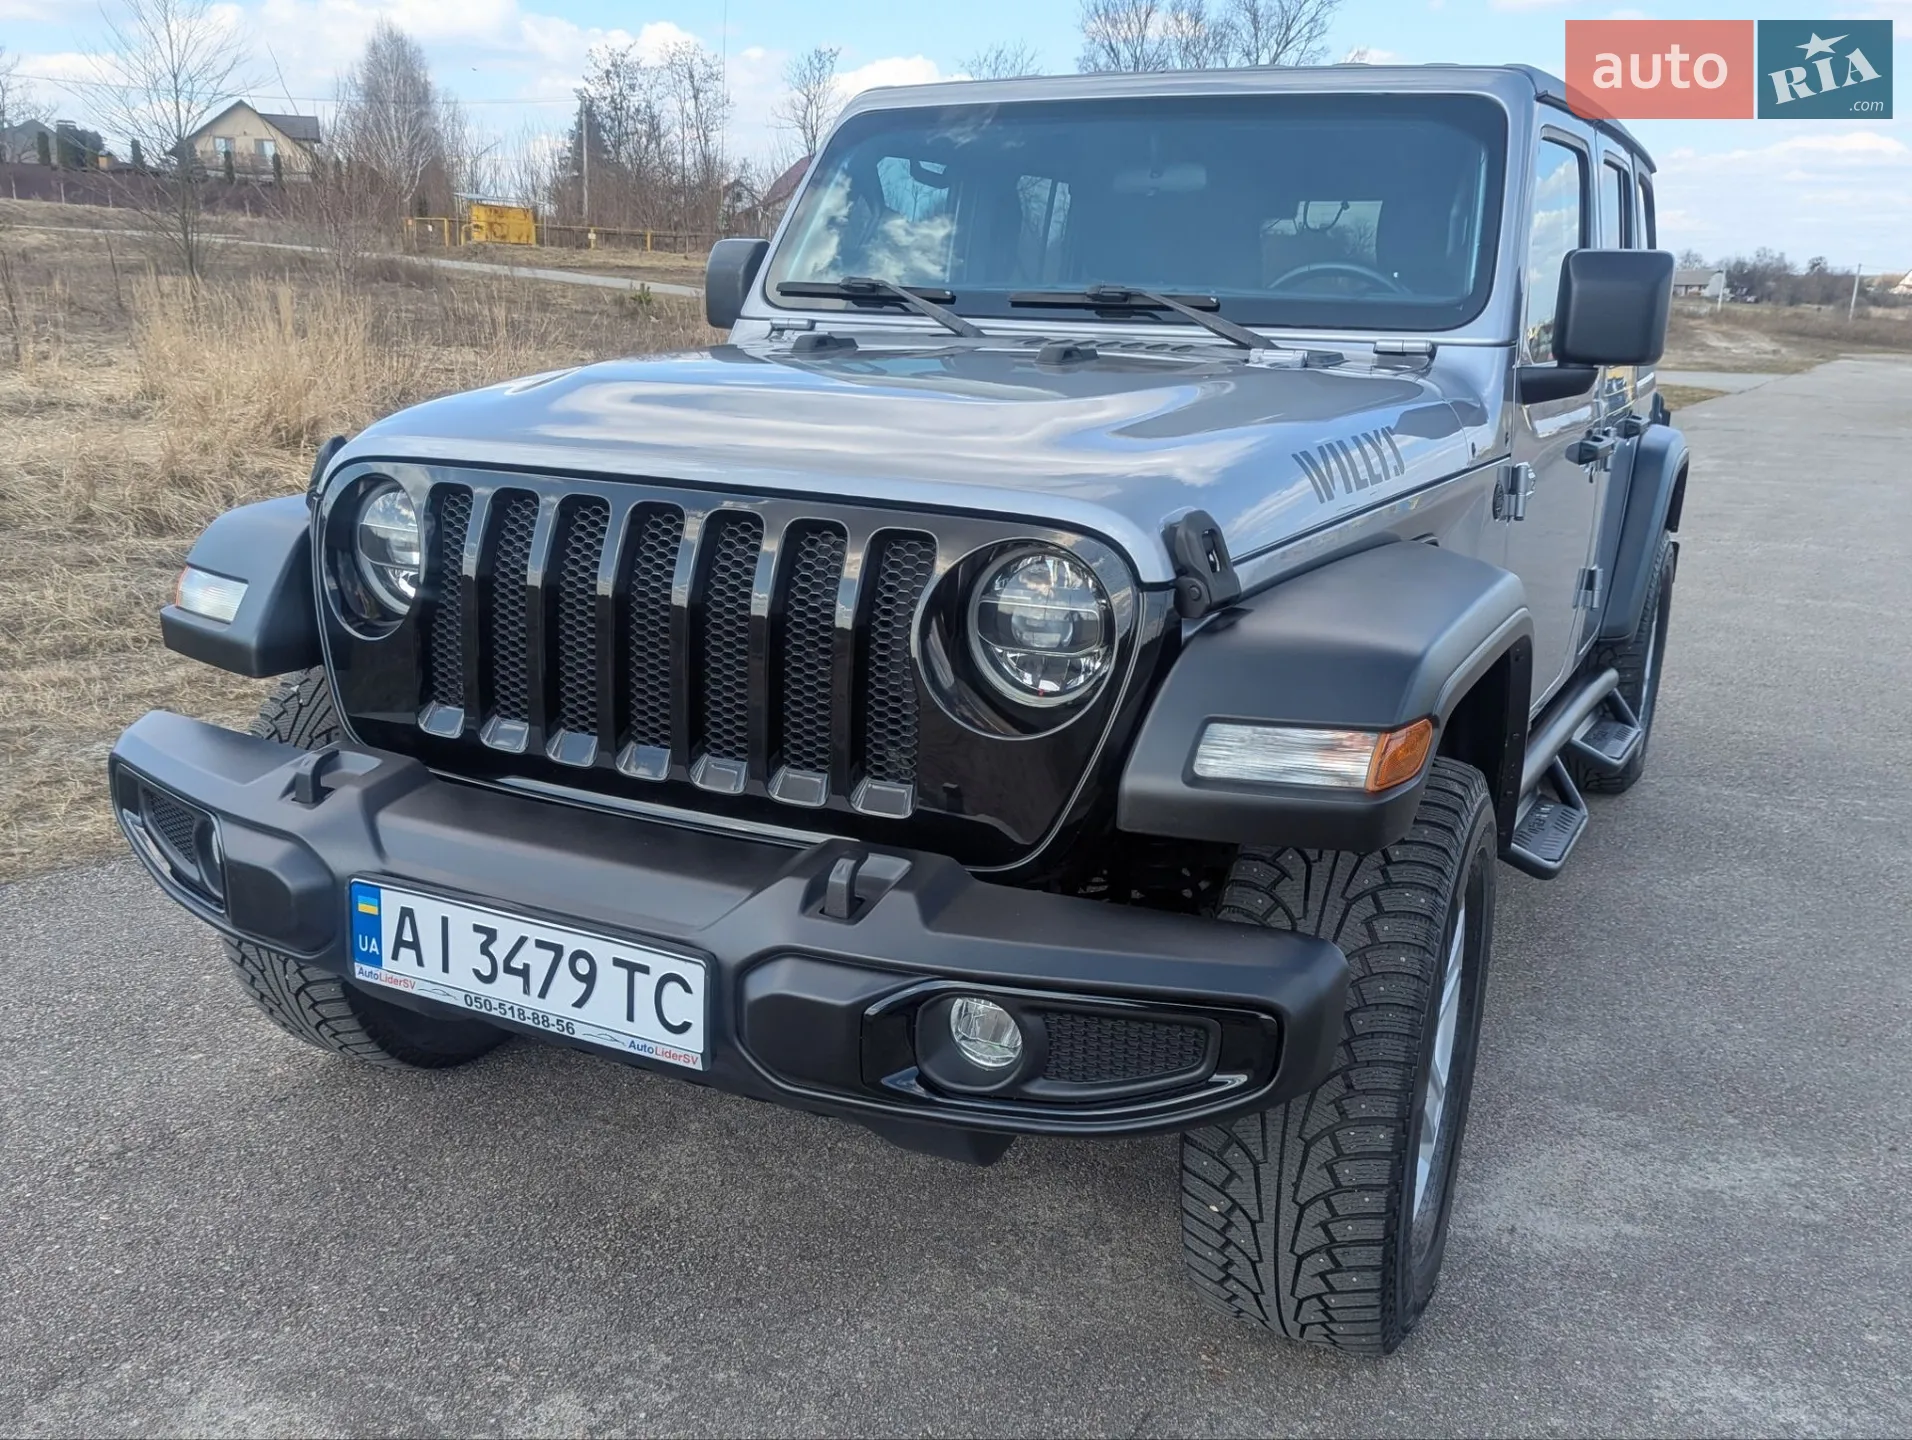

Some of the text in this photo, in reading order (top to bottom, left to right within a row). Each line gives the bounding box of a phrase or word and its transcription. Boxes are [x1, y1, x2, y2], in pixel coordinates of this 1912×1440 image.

[1291, 425, 1405, 505] WILLYS
[358, 933, 380, 956] UA
[357, 966, 416, 991] AutoLiderSV
[390, 906, 694, 1035] AI 3479 TC
[463, 993, 576, 1037] 050-518-88-56
[628, 1039, 699, 1066] AutoLiderSV
